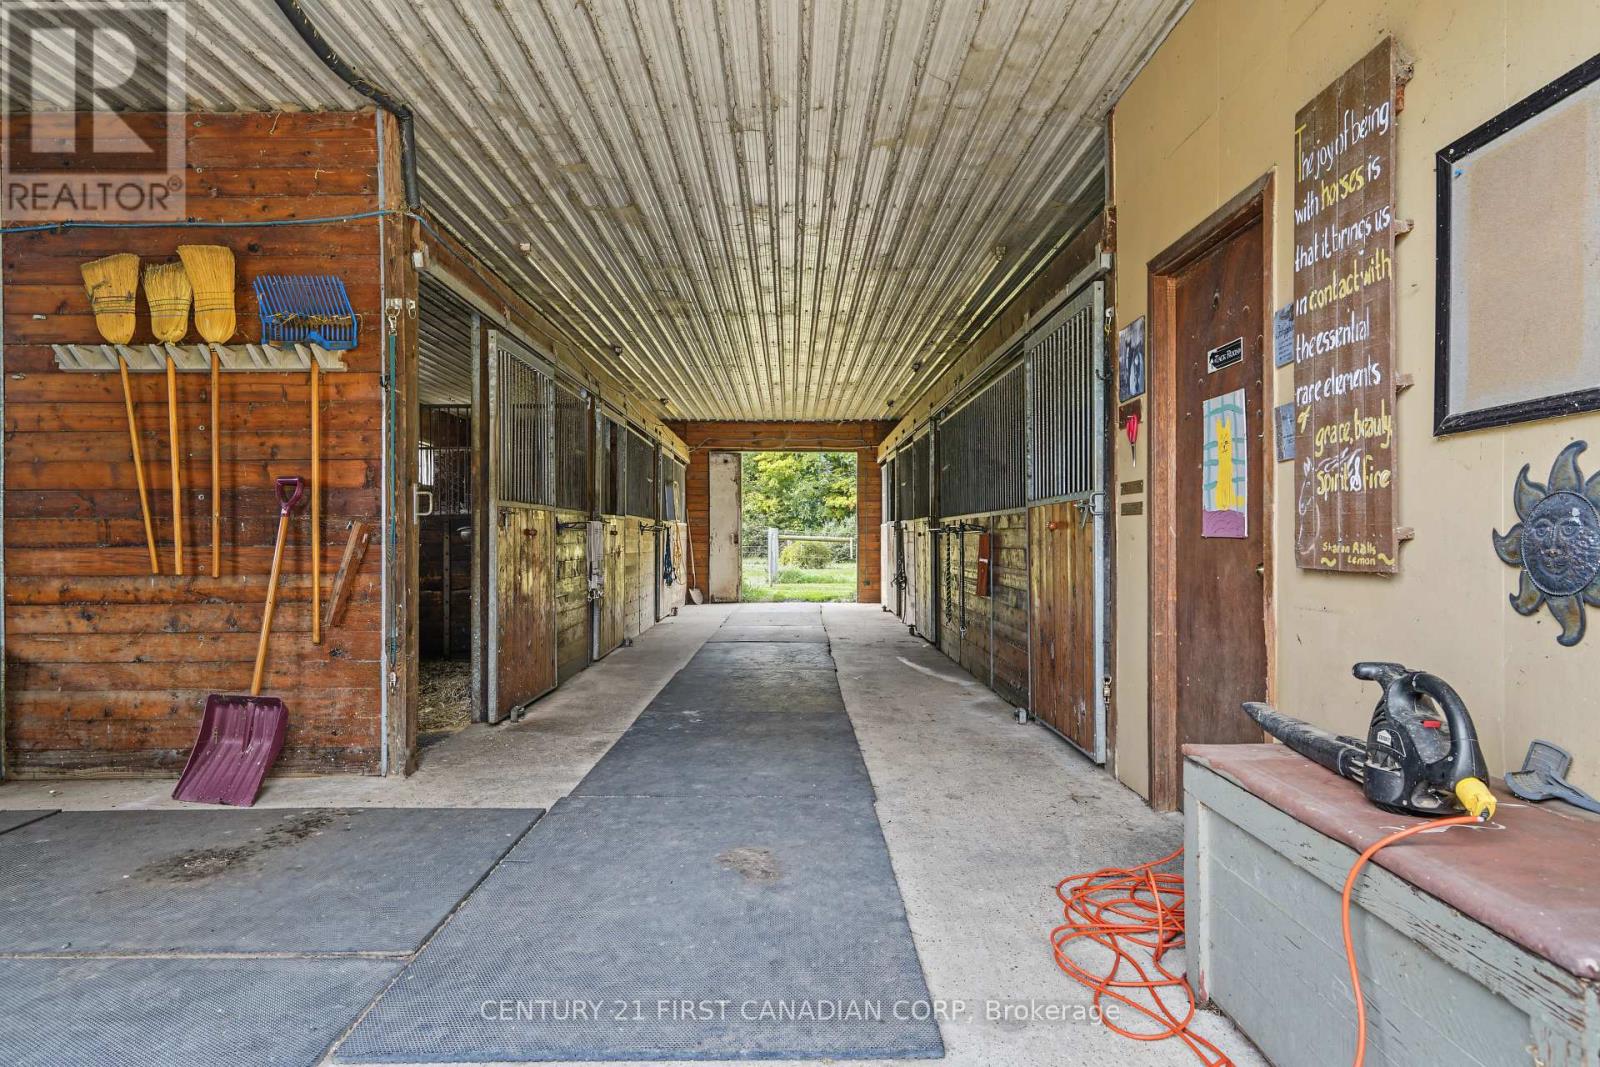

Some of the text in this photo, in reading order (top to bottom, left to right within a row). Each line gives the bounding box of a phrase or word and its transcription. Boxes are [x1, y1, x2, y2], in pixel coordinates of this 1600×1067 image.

[1295, 101, 1390, 182] The joy of being
[1295, 154, 1381, 225] with horses is
[1295, 231, 1318, 272] that
[1321, 226, 1332, 259] it
[1374, 205, 1390, 232] us
[1296, 247, 1392, 316] in contact with
[1296, 332, 1314, 364] the
[1315, 305, 1370, 355] essential
[1296, 354, 1381, 407] rare elements
